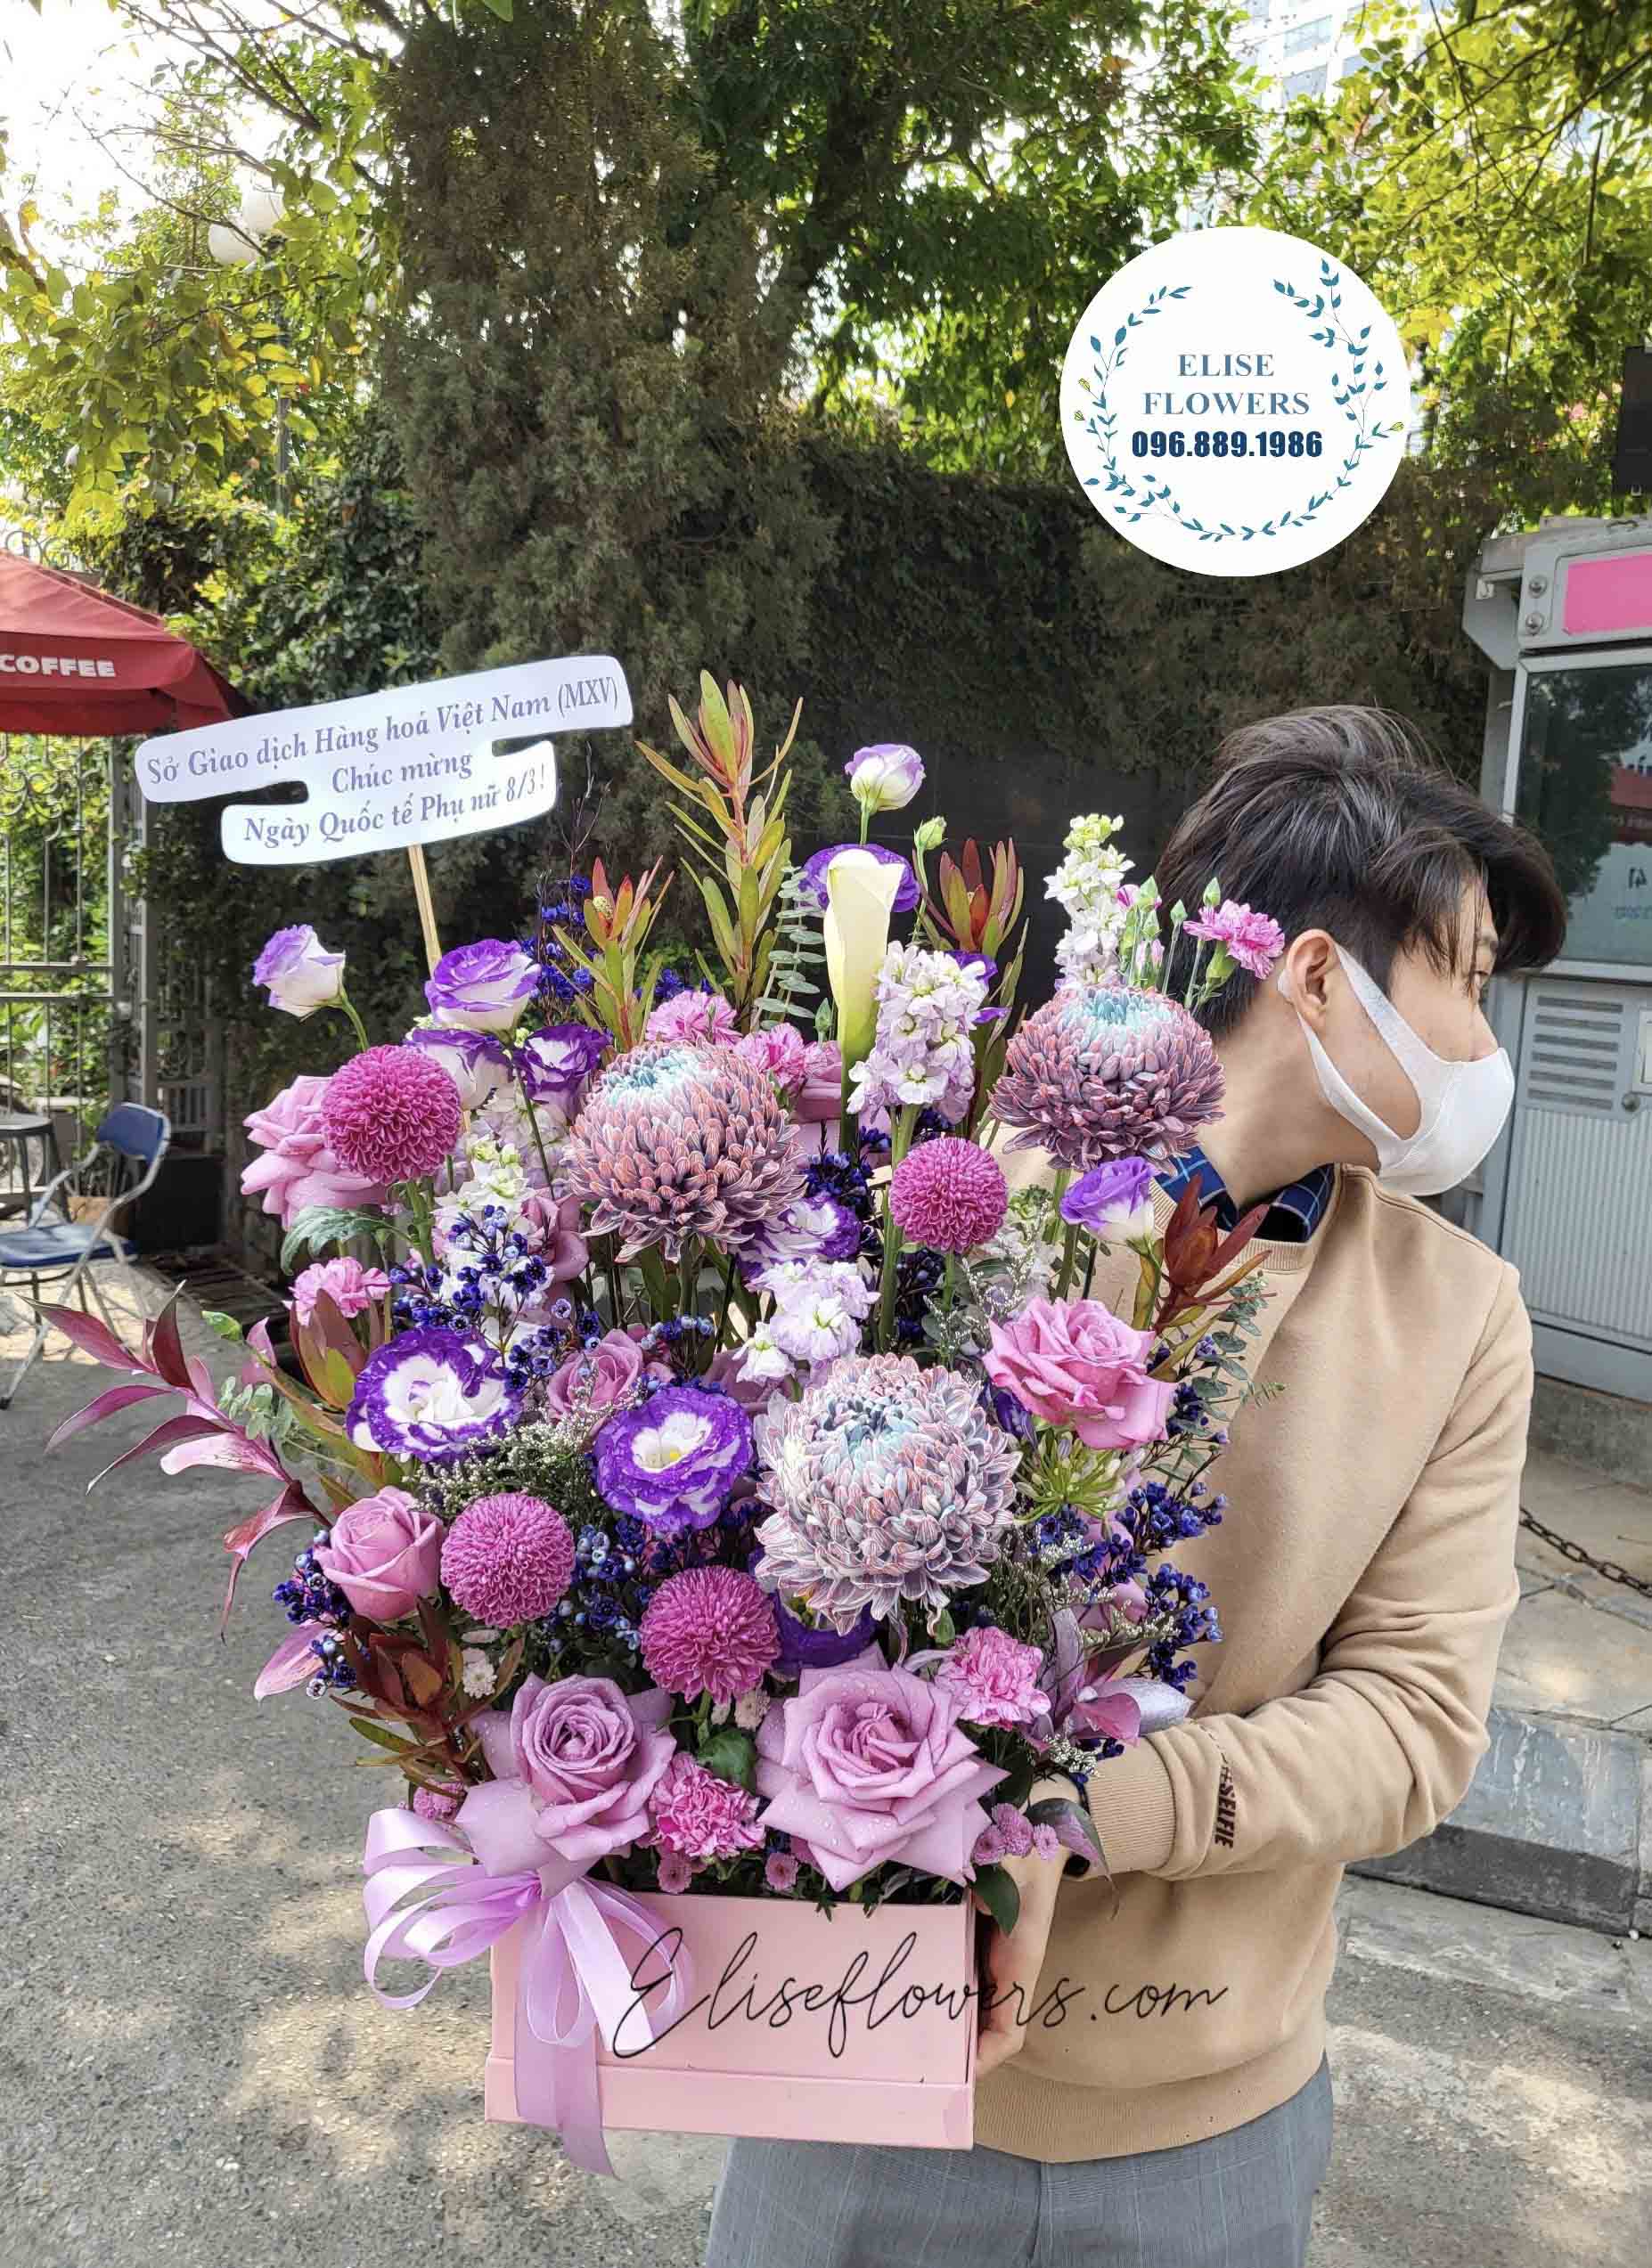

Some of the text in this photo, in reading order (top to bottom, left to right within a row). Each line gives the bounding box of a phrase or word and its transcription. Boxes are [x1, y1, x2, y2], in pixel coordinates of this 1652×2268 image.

[0, 653, 116, 678] COFFEE
[147, 676, 619, 785] Sở Giao dịch Hàng hoá Việt Nam (MXV)
[332, 753, 473, 794] Chúc mừng
[244, 817, 310, 849] Ngày
[319, 800, 385, 843] Quốc
[392, 792, 414, 827] tế
[421, 793, 464, 824] Phụ
[471, 784, 501, 812] nữ
